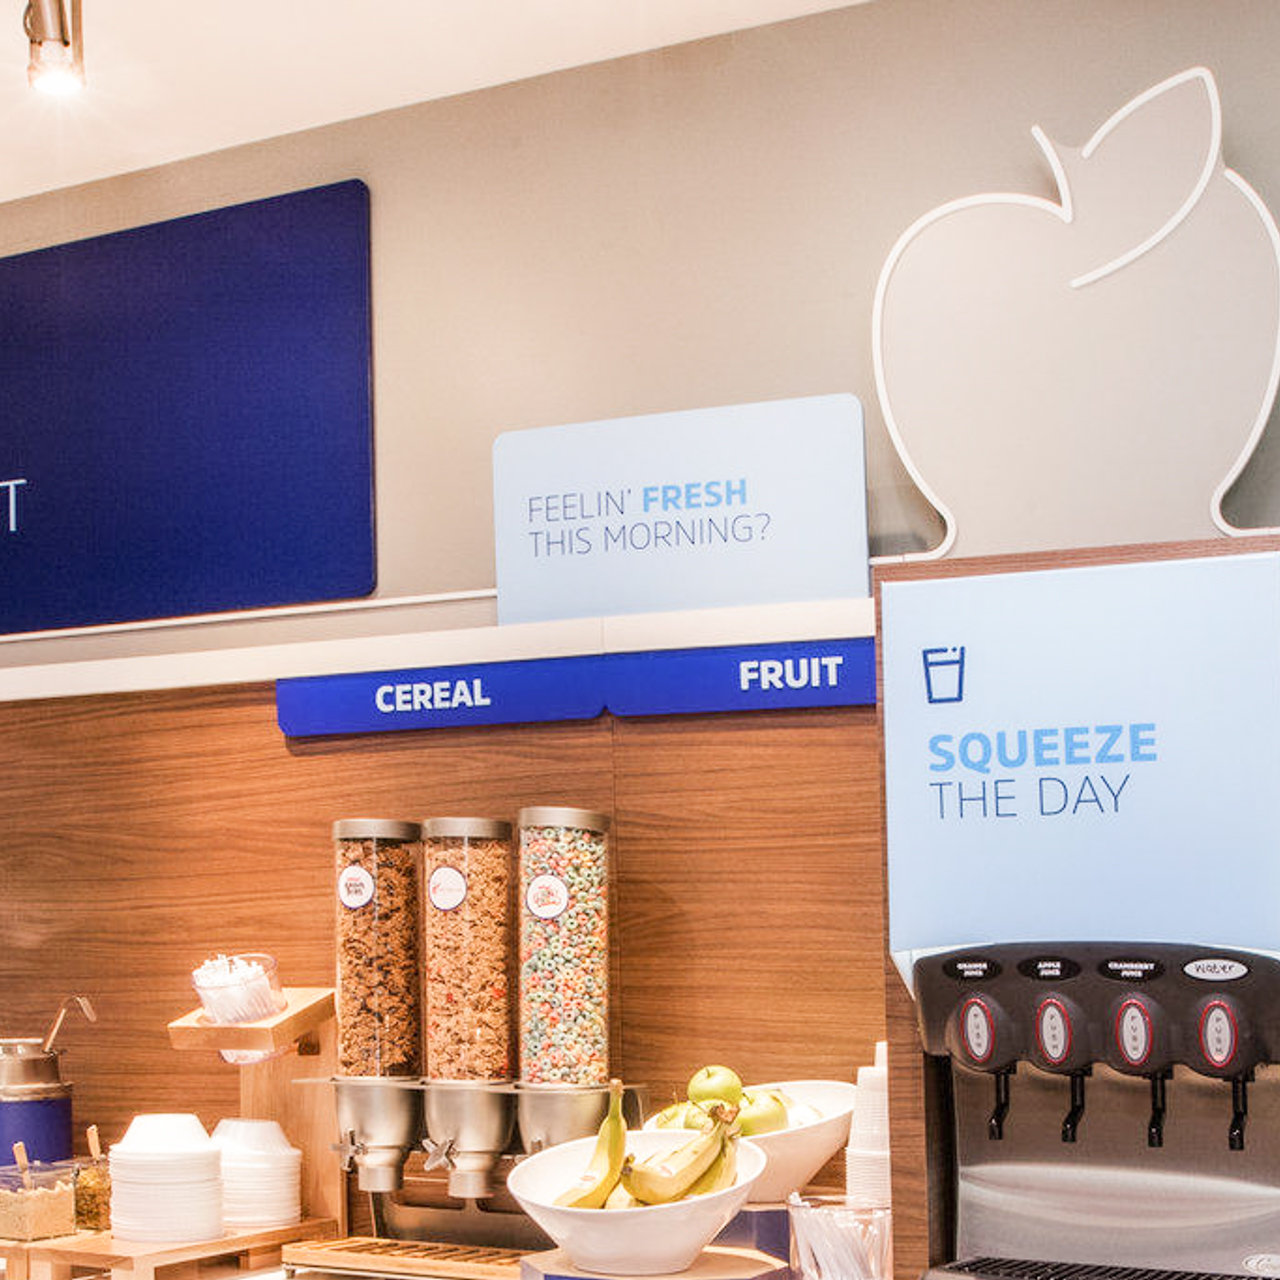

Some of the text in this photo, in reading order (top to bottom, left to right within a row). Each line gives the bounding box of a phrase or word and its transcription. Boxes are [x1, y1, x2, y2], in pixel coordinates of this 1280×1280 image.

[642, 477, 748, 514] FRESH
[528, 511, 772, 558] THIS MORNING?
[738, 655, 844, 692] FRUIT
[375, 677, 491, 713] CEREAL
[928, 722, 1158, 775] SQUEEZE
[929, 773, 1132, 819] THE DAY
